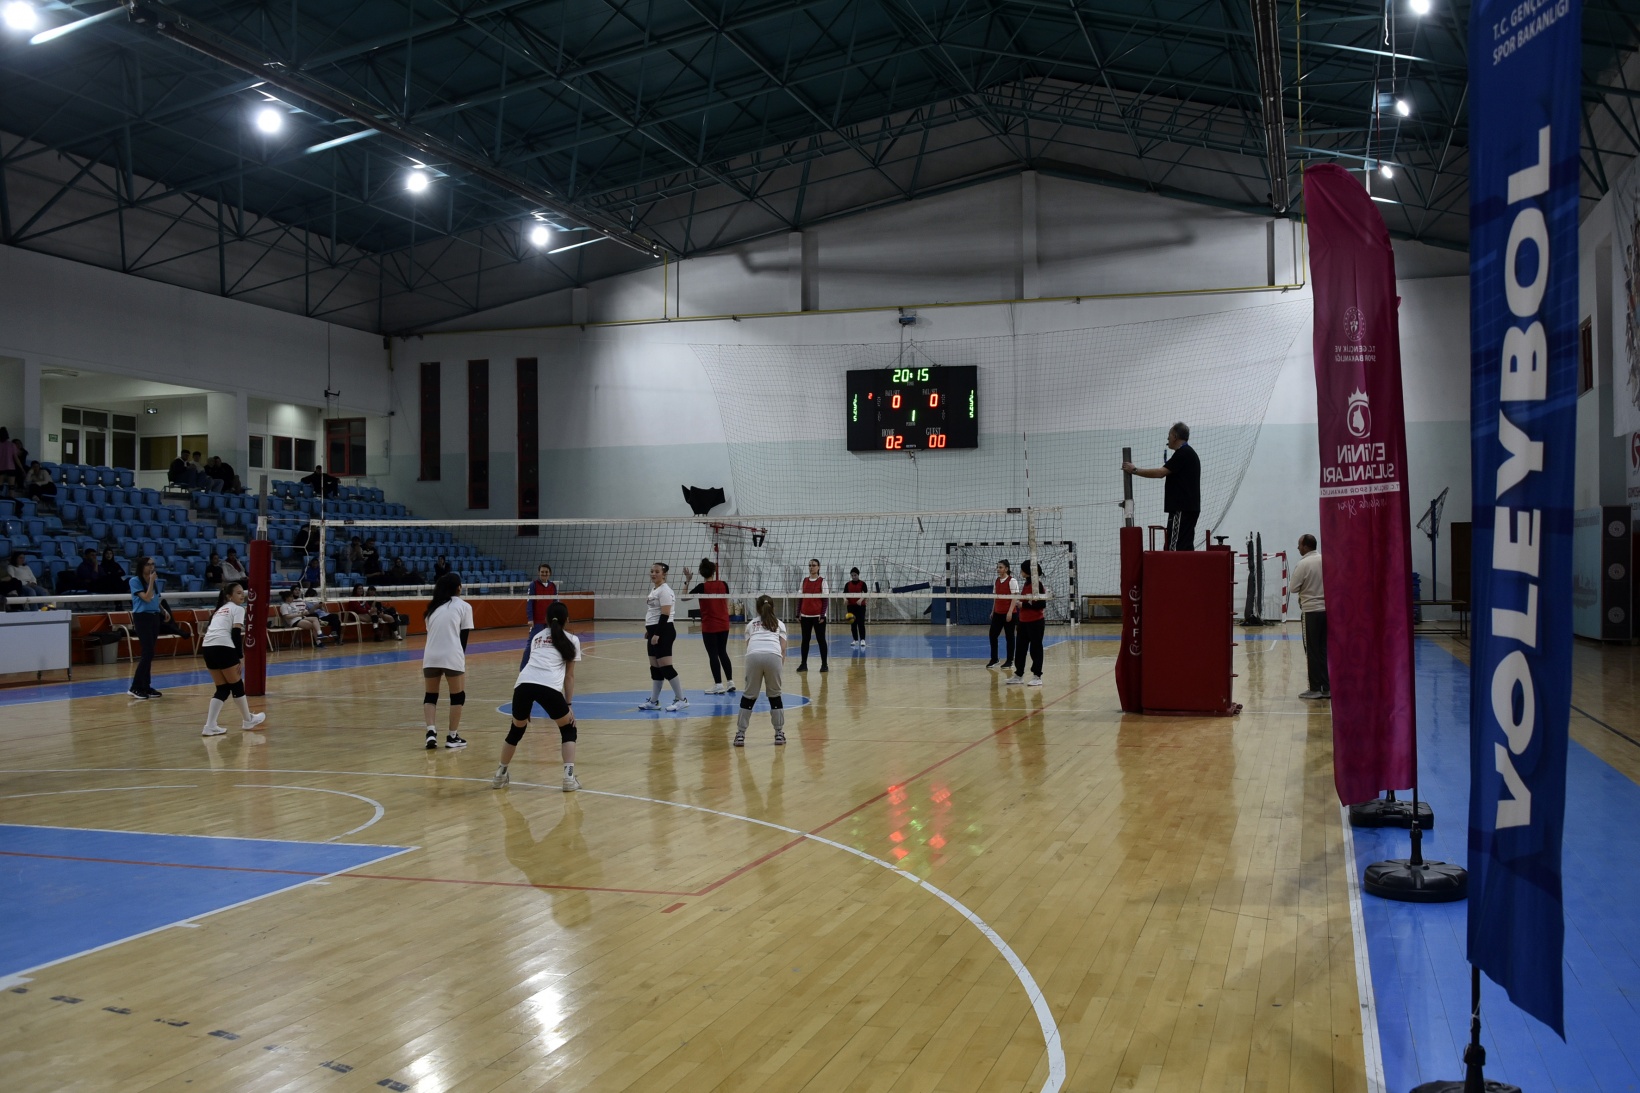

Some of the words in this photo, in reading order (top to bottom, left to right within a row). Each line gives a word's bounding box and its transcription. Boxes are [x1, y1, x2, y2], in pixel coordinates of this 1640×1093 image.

[1492, 35, 1517, 66] SPOR
[892, 368, 929, 382] 20:15
[892, 395, 901, 409] 0
[929, 394, 939, 407] 0
[885, 435, 903, 449] 02
[928, 434, 946, 448] 00
[1491, 124, 1551, 830] VOLEYBOL
